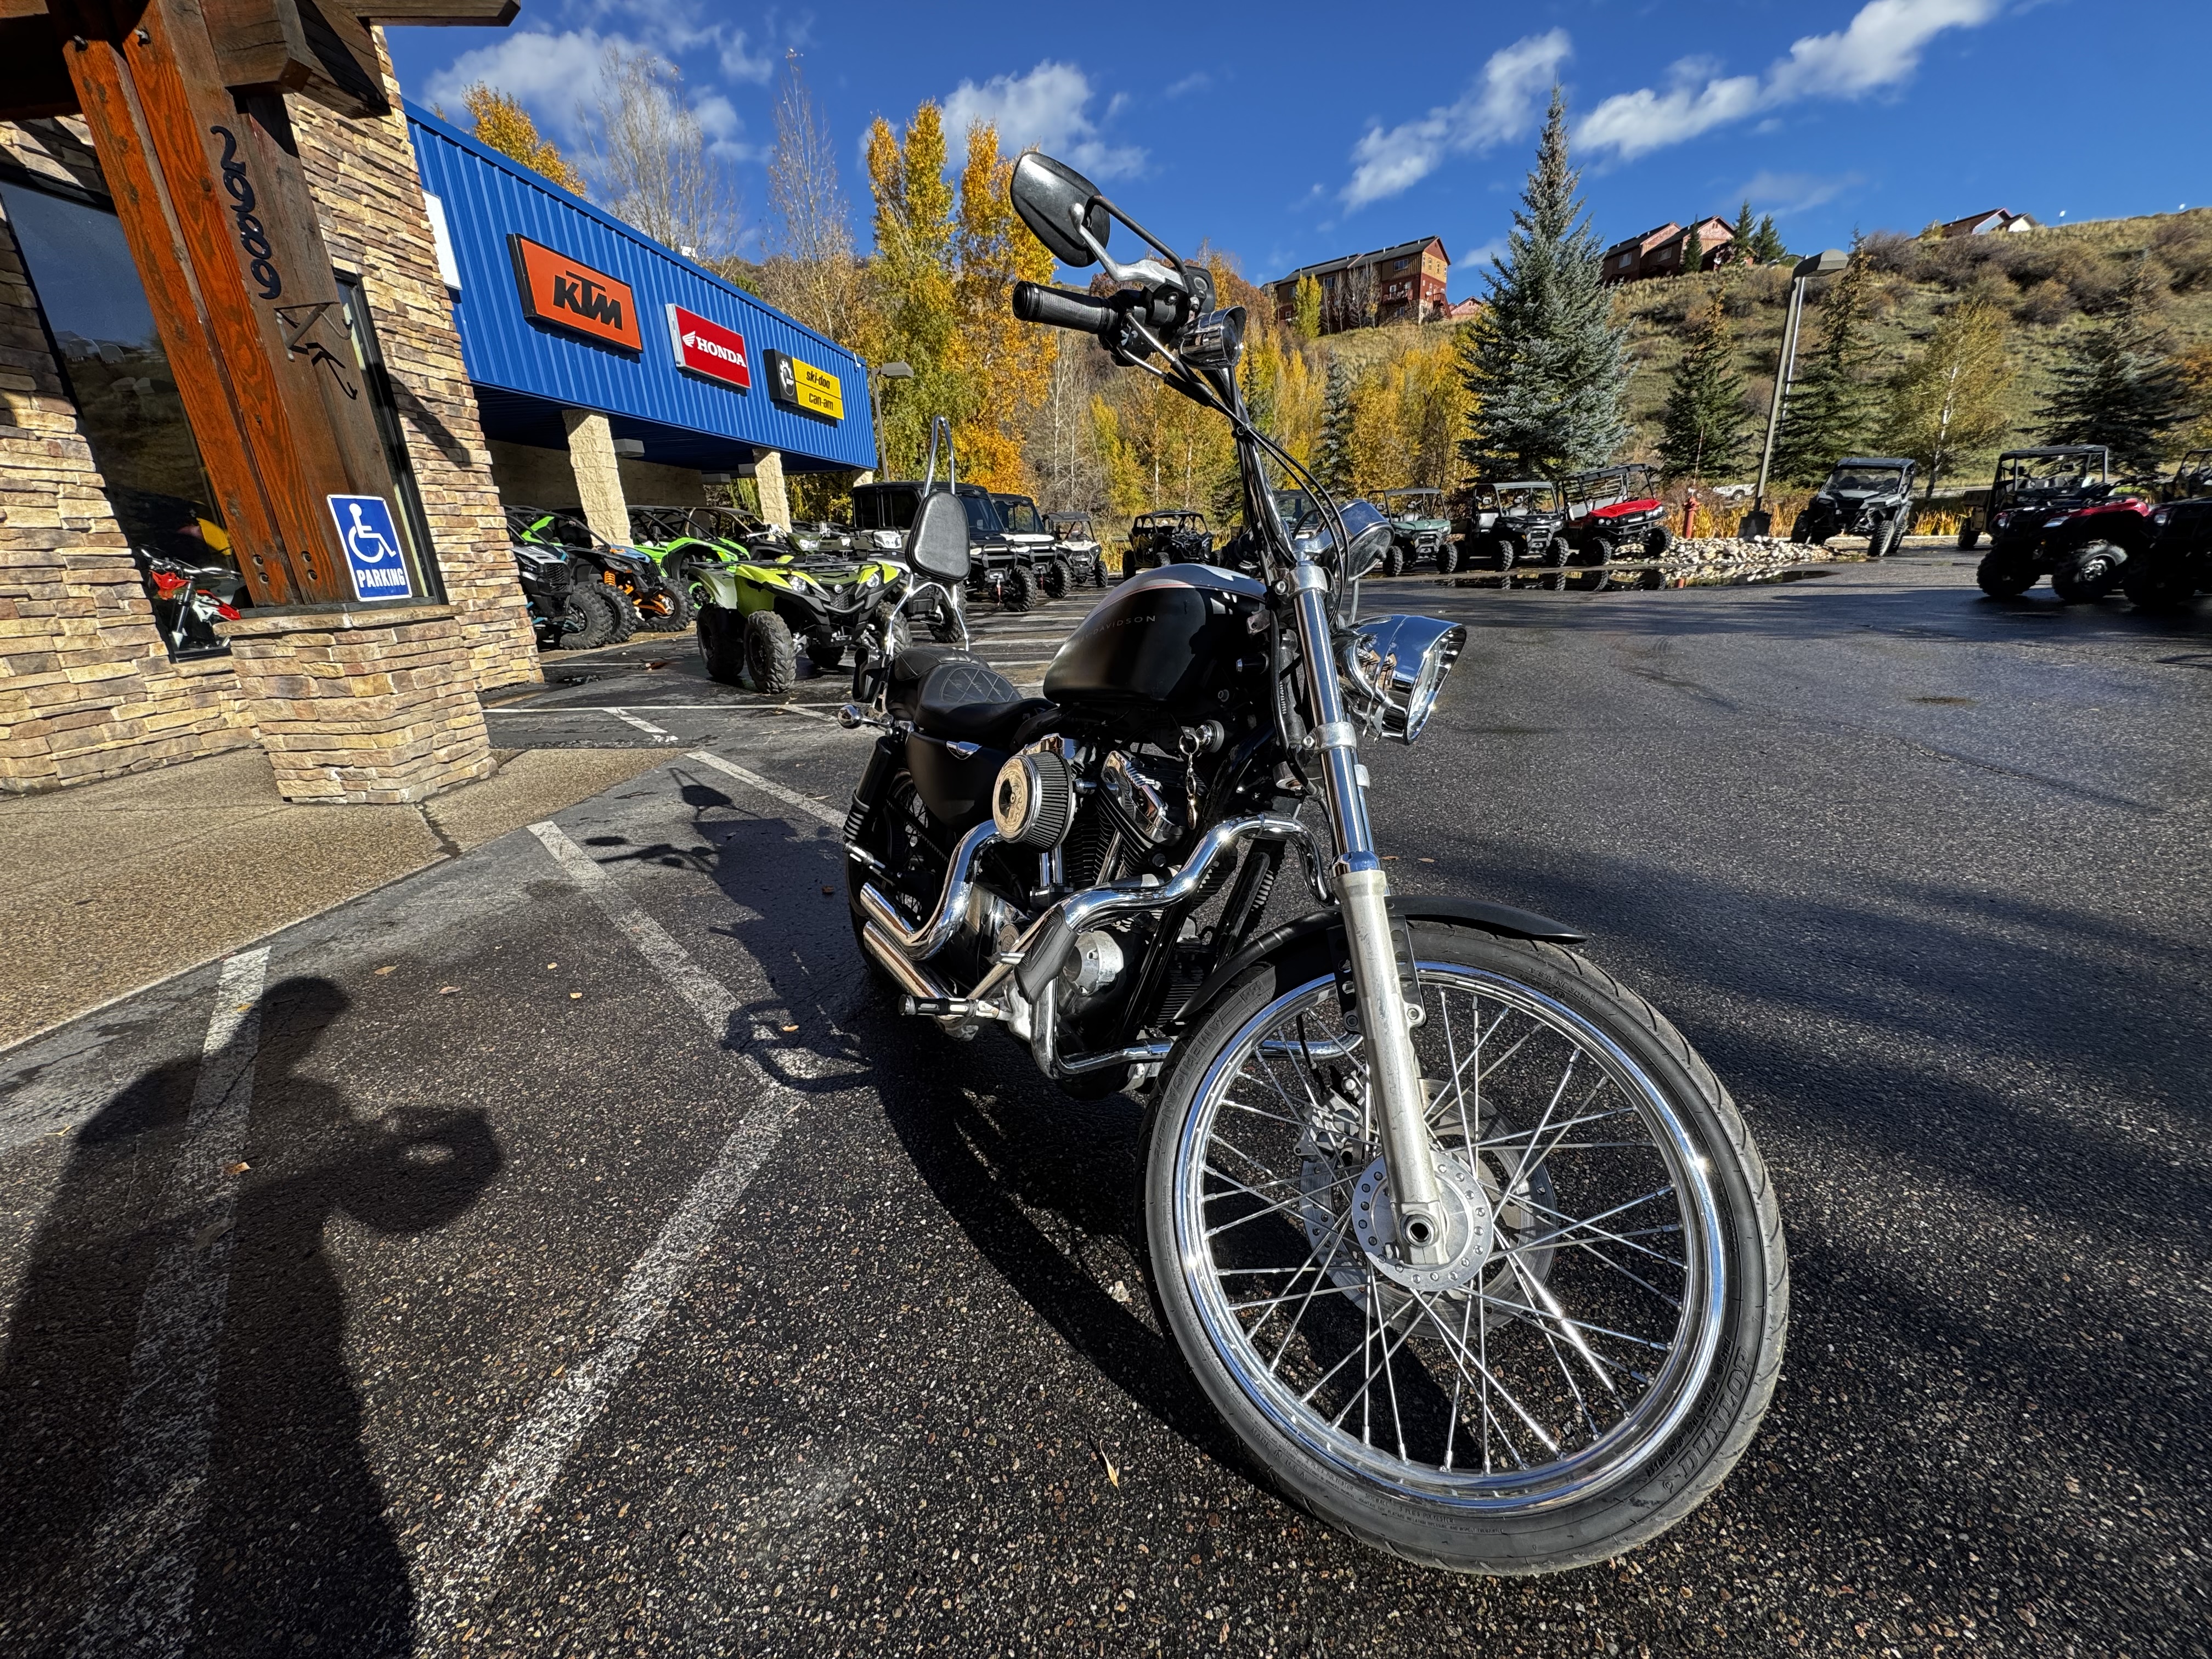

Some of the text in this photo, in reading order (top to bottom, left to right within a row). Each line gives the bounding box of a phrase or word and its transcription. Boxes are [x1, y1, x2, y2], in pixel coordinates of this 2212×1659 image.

[210, 125, 281, 300] 2989
[553, 270, 623, 330] KTM
[696, 336, 747, 368] HONDA
[806, 370, 831, 390] ski-doo
[809, 392, 834, 411] can-am
[356, 568, 406, 588] PARKING
[1153, 1014, 1227, 1158] AMERICAN ELITE
[1677, 1346, 1753, 1480] DUNLOP
[1272, 1448, 1283, 1460] IN
